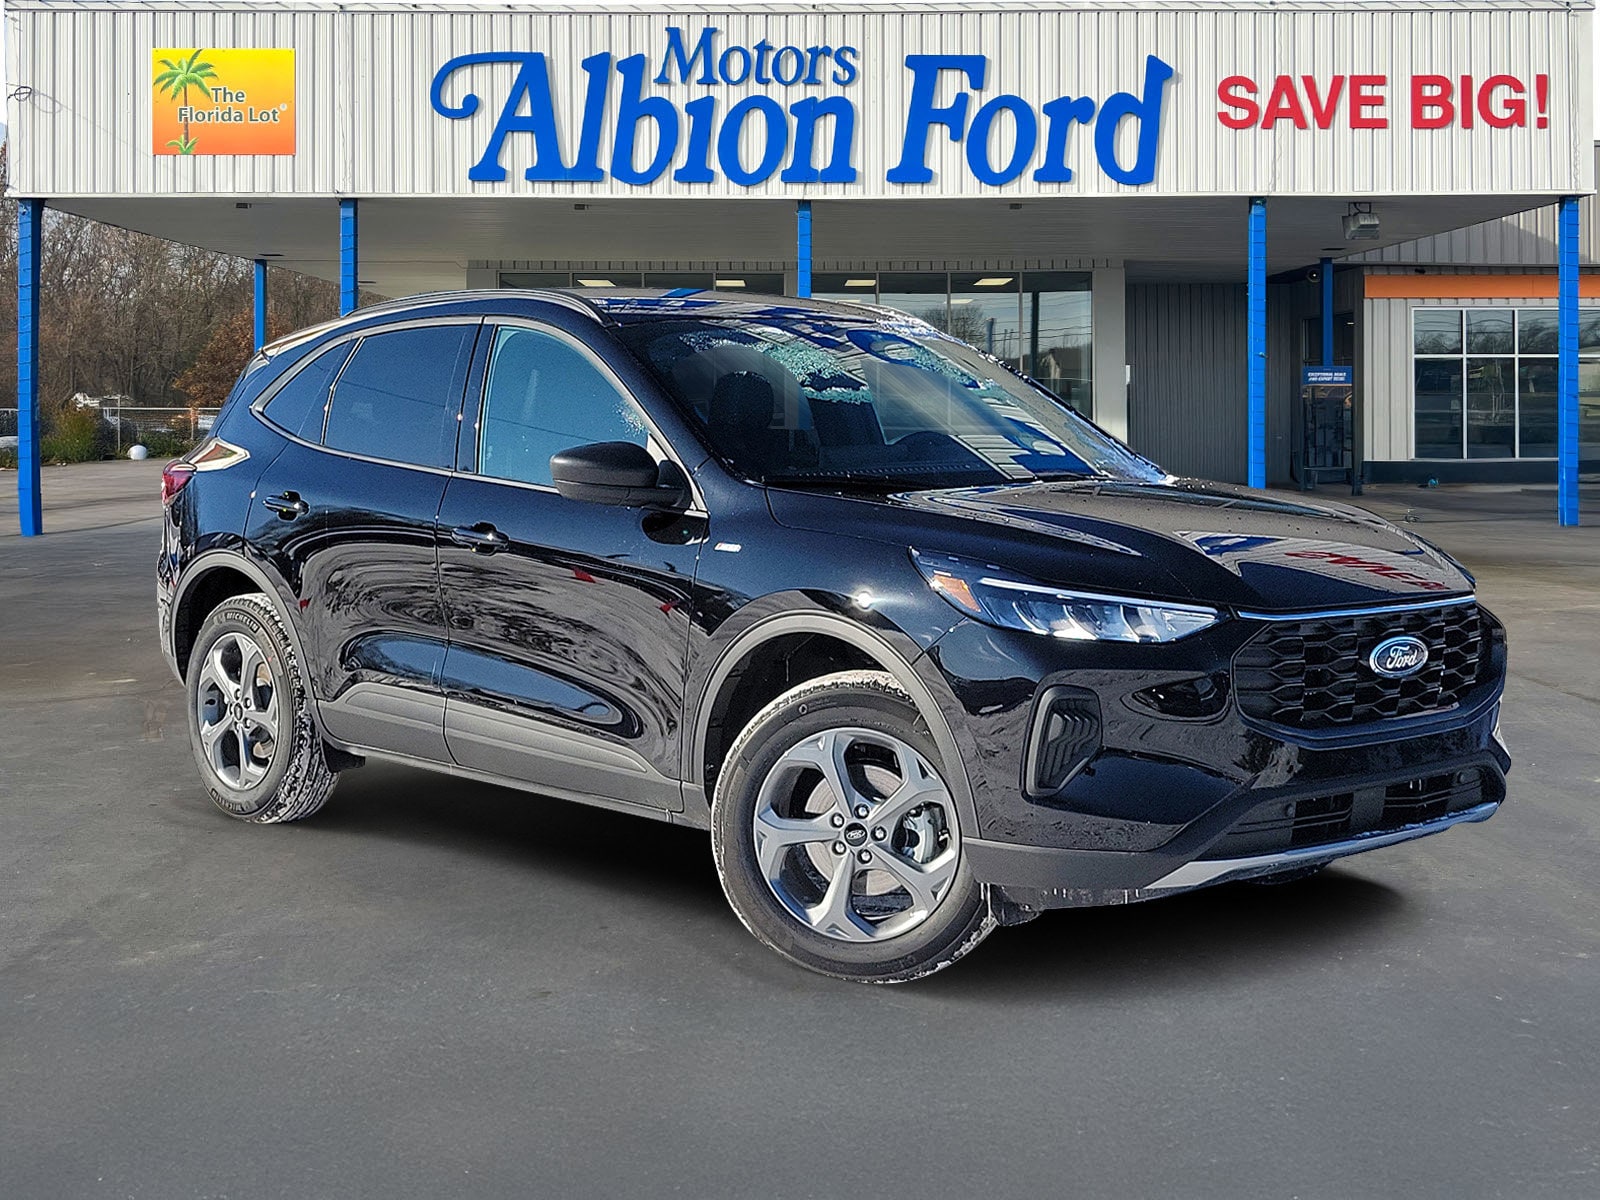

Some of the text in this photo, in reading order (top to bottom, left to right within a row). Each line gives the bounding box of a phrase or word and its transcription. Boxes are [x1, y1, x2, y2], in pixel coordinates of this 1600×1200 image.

[655, 27, 857, 86] Motors
[210, 86, 246, 103] The
[1218, 74, 1548, 129] SAVE BIG!
[177, 106, 244, 123] Florida
[430, 52, 1174, 186] Albion Ford
[1386, 645, 1418, 669] Ford
